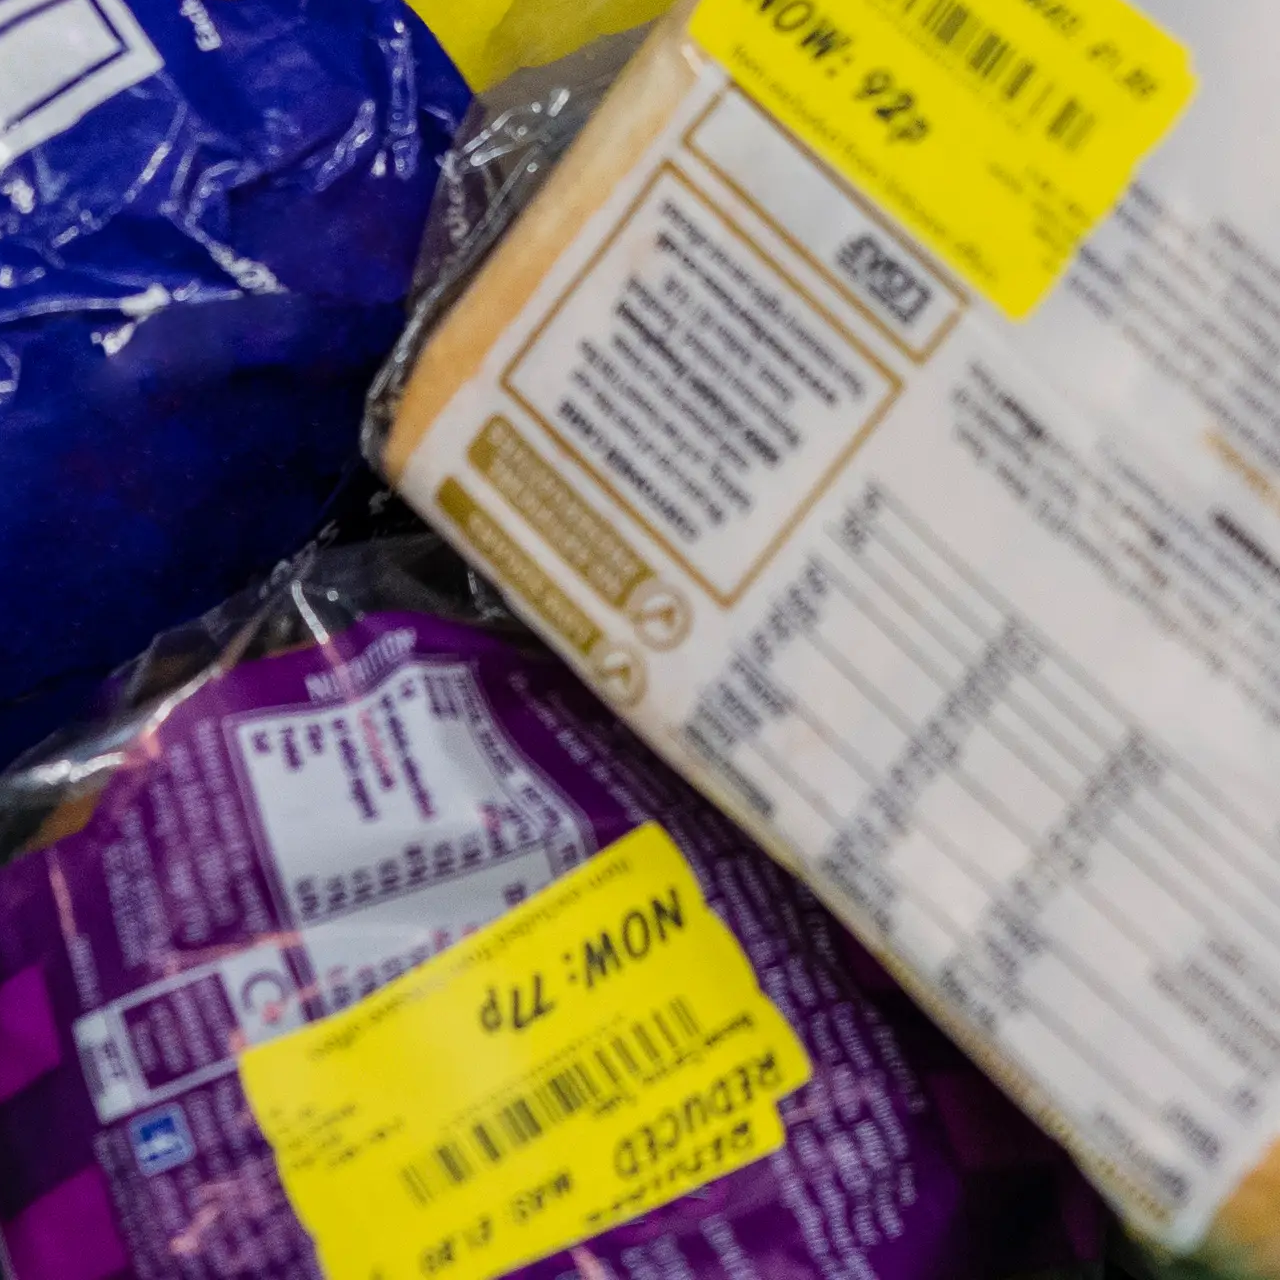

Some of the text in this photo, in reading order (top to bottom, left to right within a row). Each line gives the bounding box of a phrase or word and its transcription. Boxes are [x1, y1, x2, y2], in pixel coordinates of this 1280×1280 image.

[854, 70, 933, 144] 92p
[479, 887, 686, 1034] NOW: 77p
[614, 1049, 794, 1177] REDUCED
